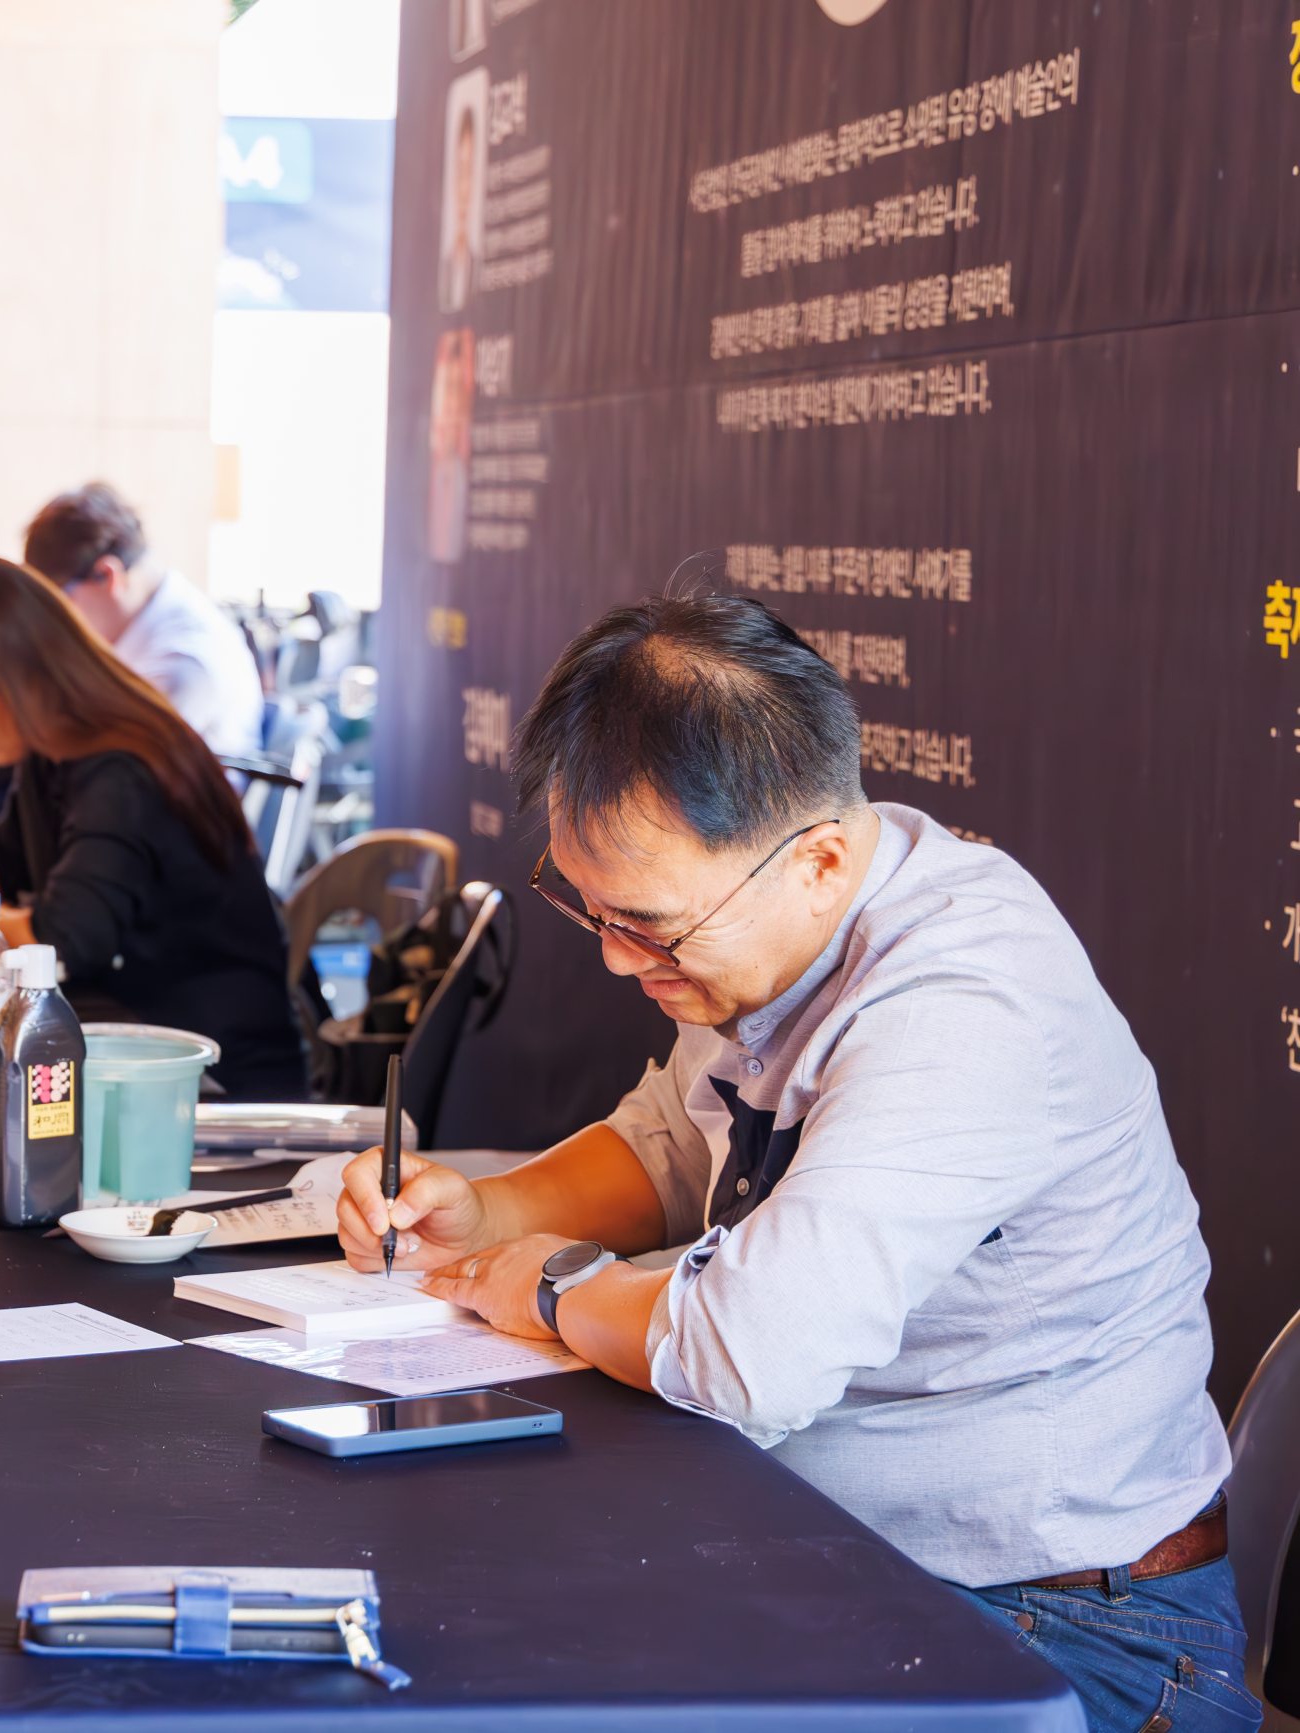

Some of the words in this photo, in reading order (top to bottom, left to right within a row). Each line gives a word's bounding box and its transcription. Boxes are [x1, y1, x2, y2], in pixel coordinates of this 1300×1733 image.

[1013, 48, 1081, 120] 예술인의
[917, 175, 980, 238] 있습니다.
[903, 273, 950, 331] 성장을
[926, 360, 992, 416] 있습니다.
[912, 729, 977, 789] 있습니다.
